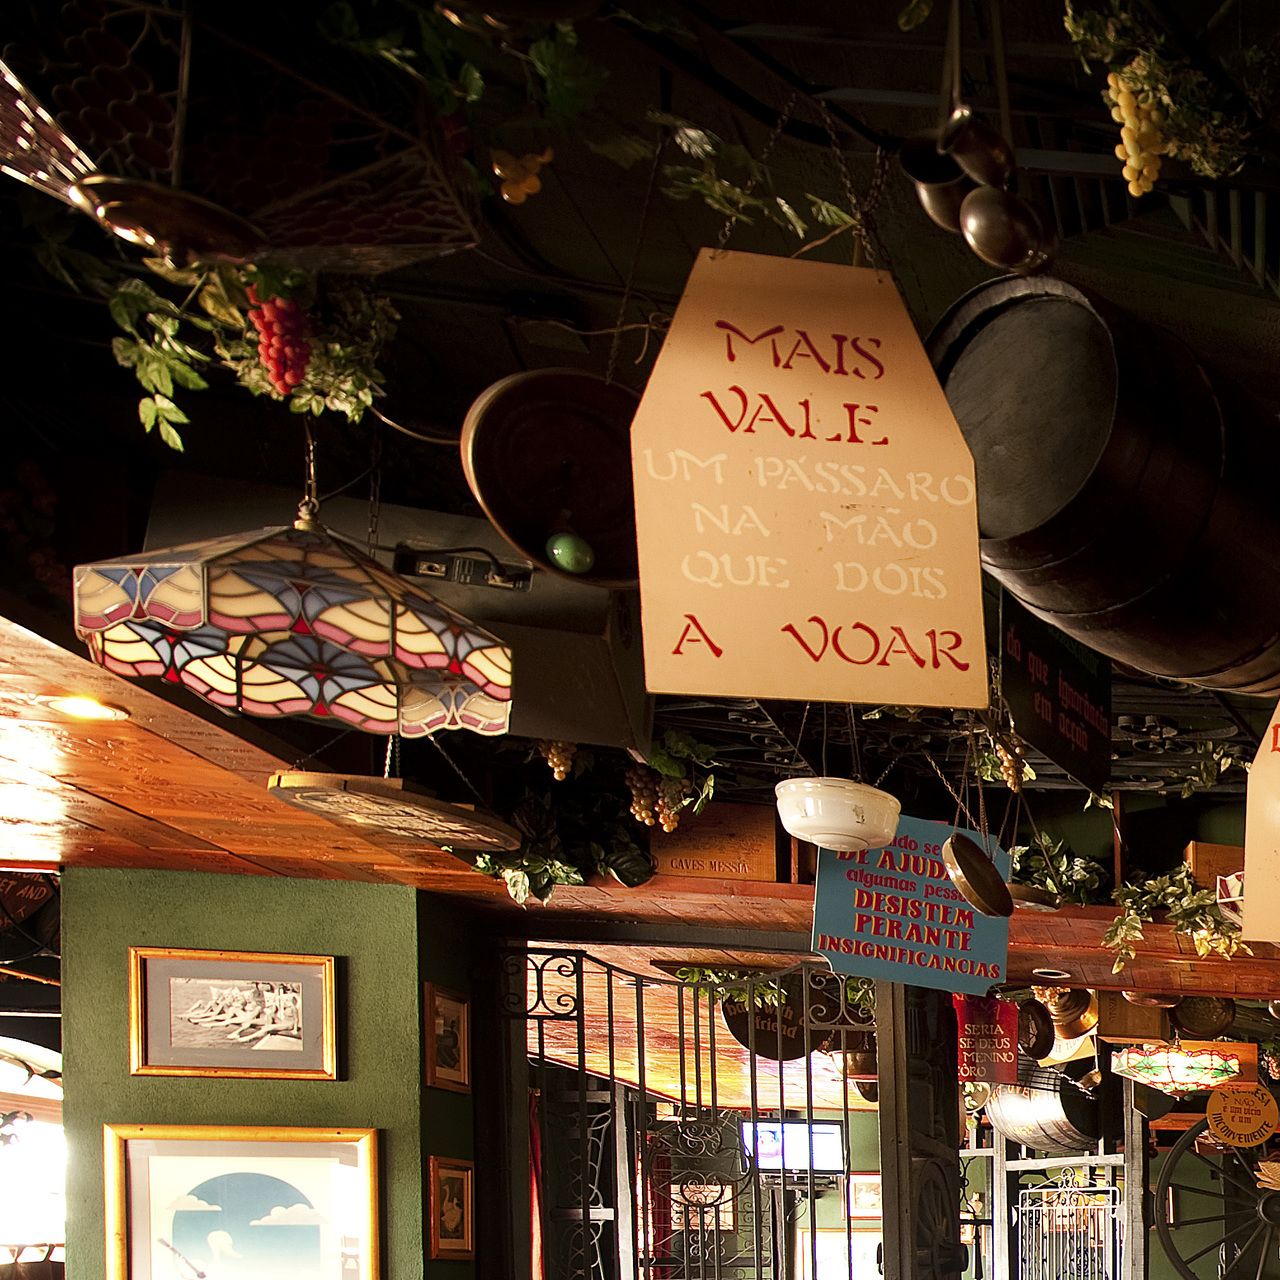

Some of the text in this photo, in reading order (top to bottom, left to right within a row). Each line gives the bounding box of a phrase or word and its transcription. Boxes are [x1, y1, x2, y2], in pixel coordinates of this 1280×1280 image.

[715, 320, 884, 380] MAIS
[700, 385, 889, 446] VALE
[643, 448, 974, 506] UM PÁSSARO
[692, 503, 938, 549] NA MÃO
[681, 550, 948, 600] QUE DOIS
[671, 613, 970, 672] A VOAR
[670, 858, 705, 871] CAVES
[876, 849, 951, 881] AJUDA
[16, 885, 48, 900] AND
[846, 868, 965, 903] algumas pesso
[854, 888, 975, 930] DESISTEM
[854, 913, 972, 951] PERANTE
[818, 934, 1000, 979] INSIGNIFICANCIAS
[754, 1015, 798, 1039] friend
[959, 1038, 1011, 1049] SE DEUS
[964, 1023, 1004, 1035] SERIA
[958, 1064, 987, 1077] ÔRO
[963, 1051, 1014, 1063] MENINO
[1233, 1096, 1255, 1106] NÃO
